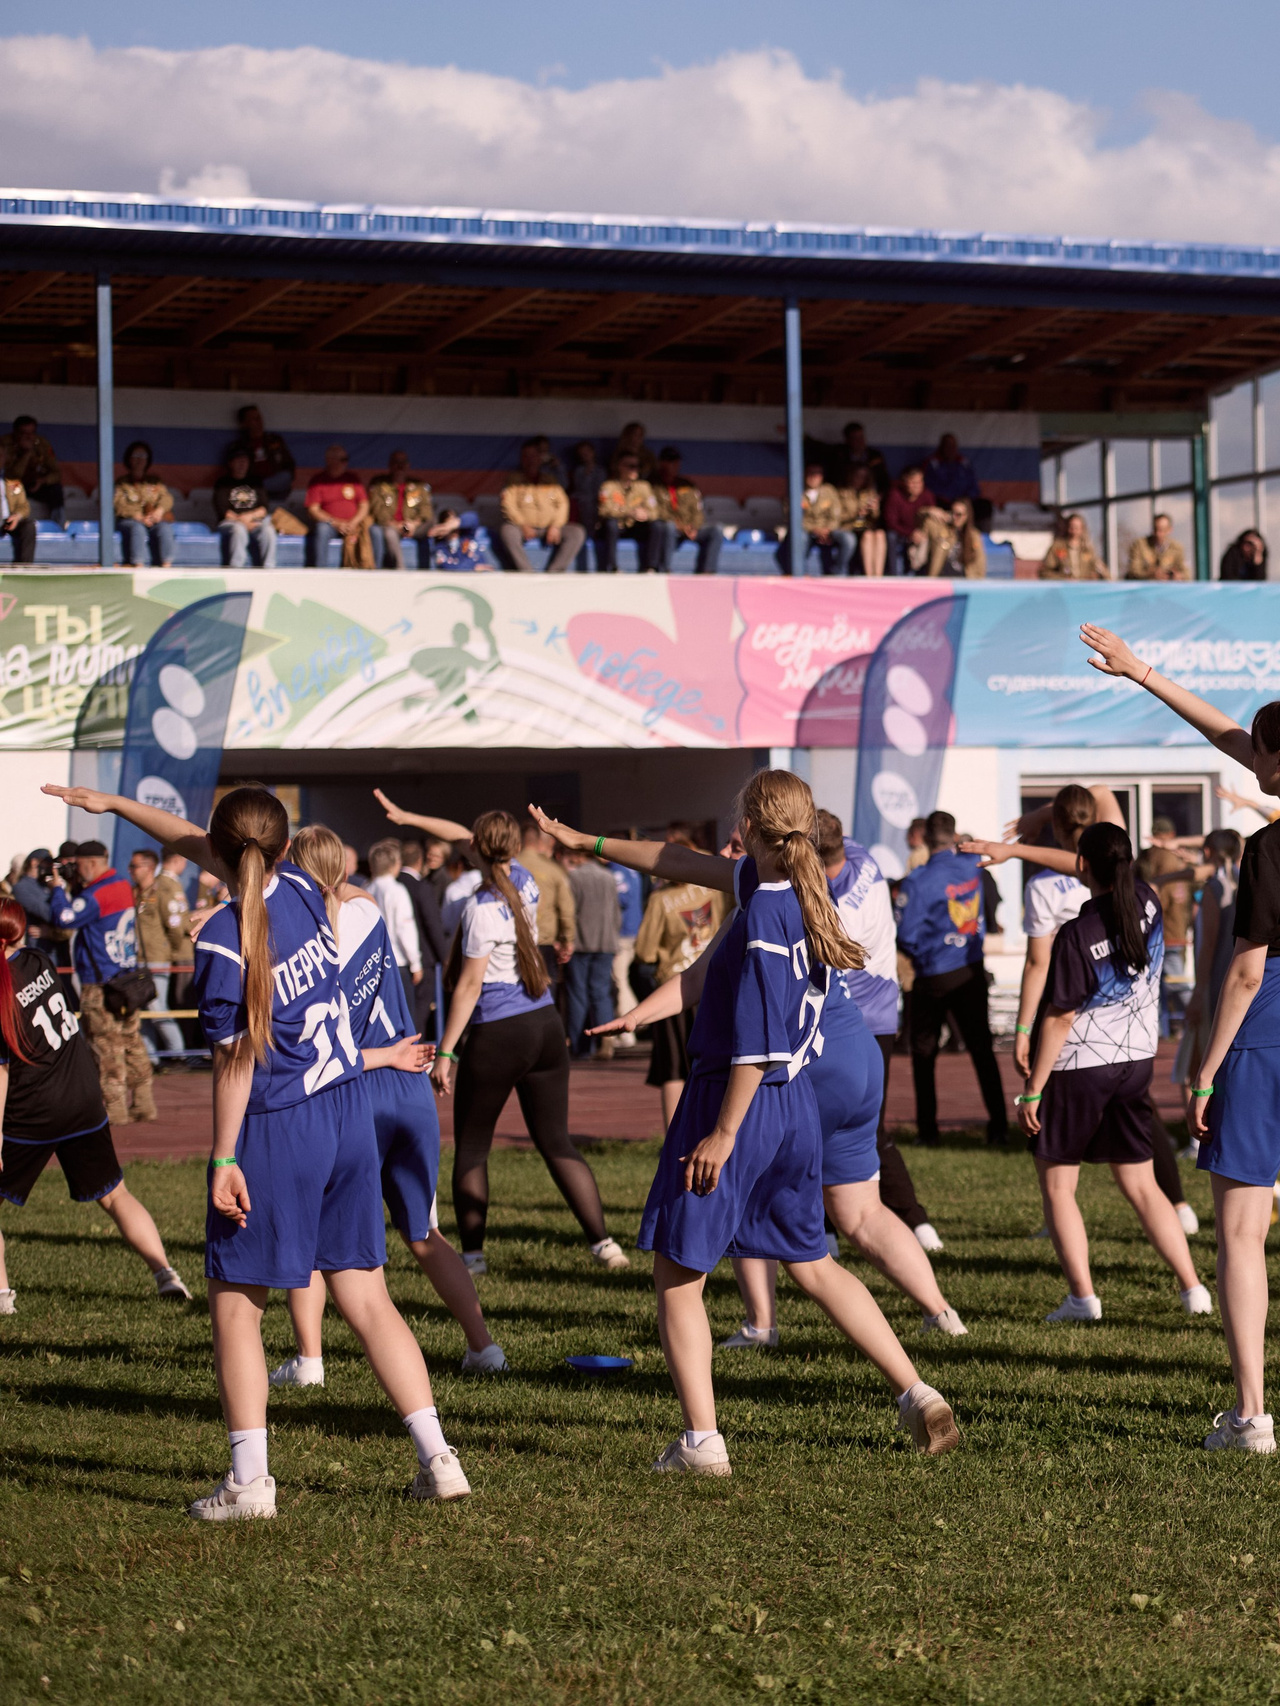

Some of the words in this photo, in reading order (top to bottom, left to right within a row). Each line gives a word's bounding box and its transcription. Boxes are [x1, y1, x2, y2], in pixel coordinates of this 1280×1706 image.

[577, 640, 705, 727] победе
[15, 968, 55, 1008] BERKUT
[271, 922, 341, 1007] ПЕРРО
[32, 991, 80, 1052] 13
